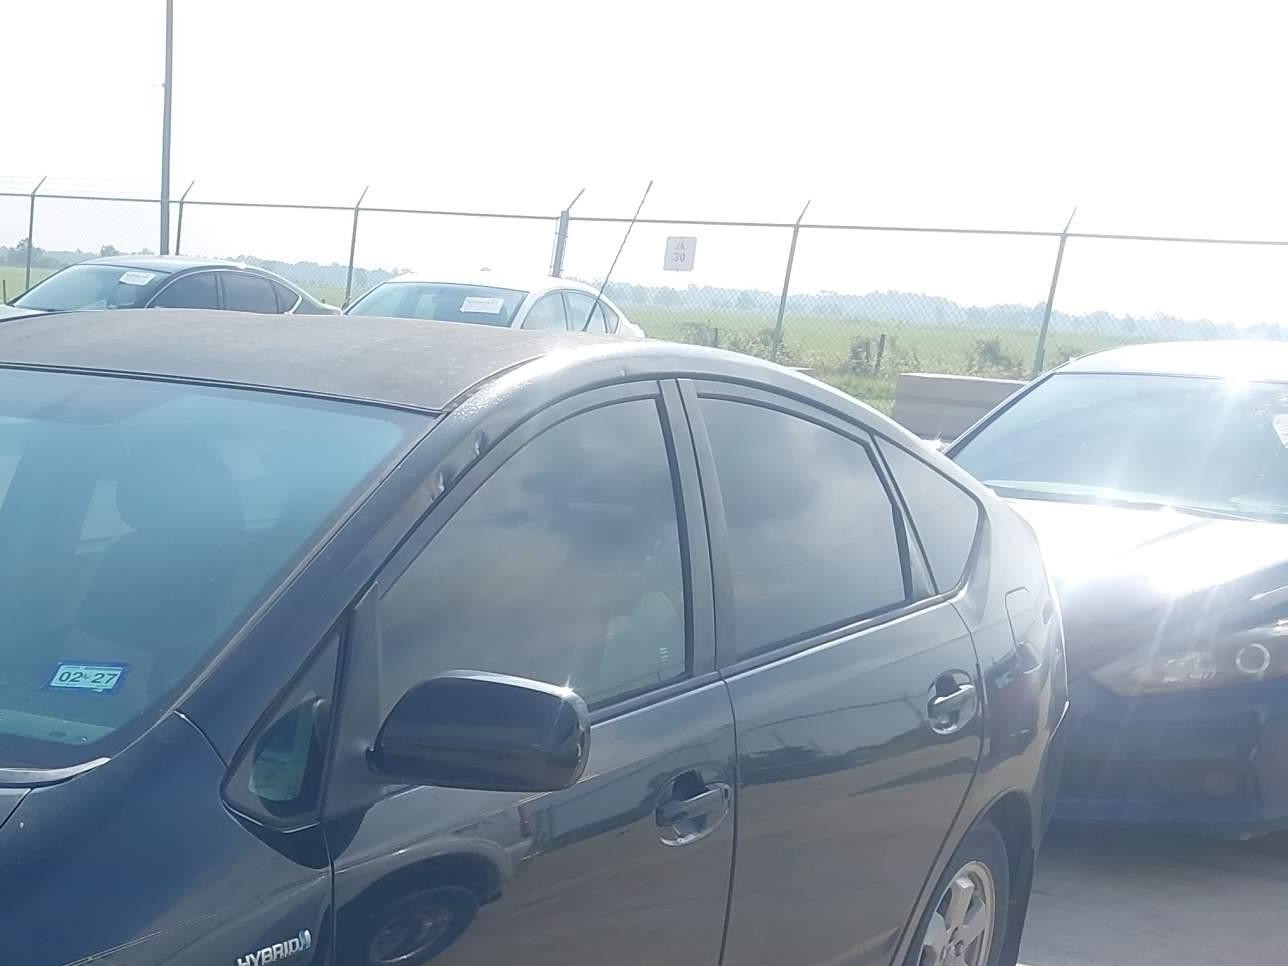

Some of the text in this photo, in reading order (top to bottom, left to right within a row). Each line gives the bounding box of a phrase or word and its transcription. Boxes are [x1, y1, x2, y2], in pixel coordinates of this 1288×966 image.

[672, 252, 686, 263] 30
[58, 671, 118, 684] 02 27
